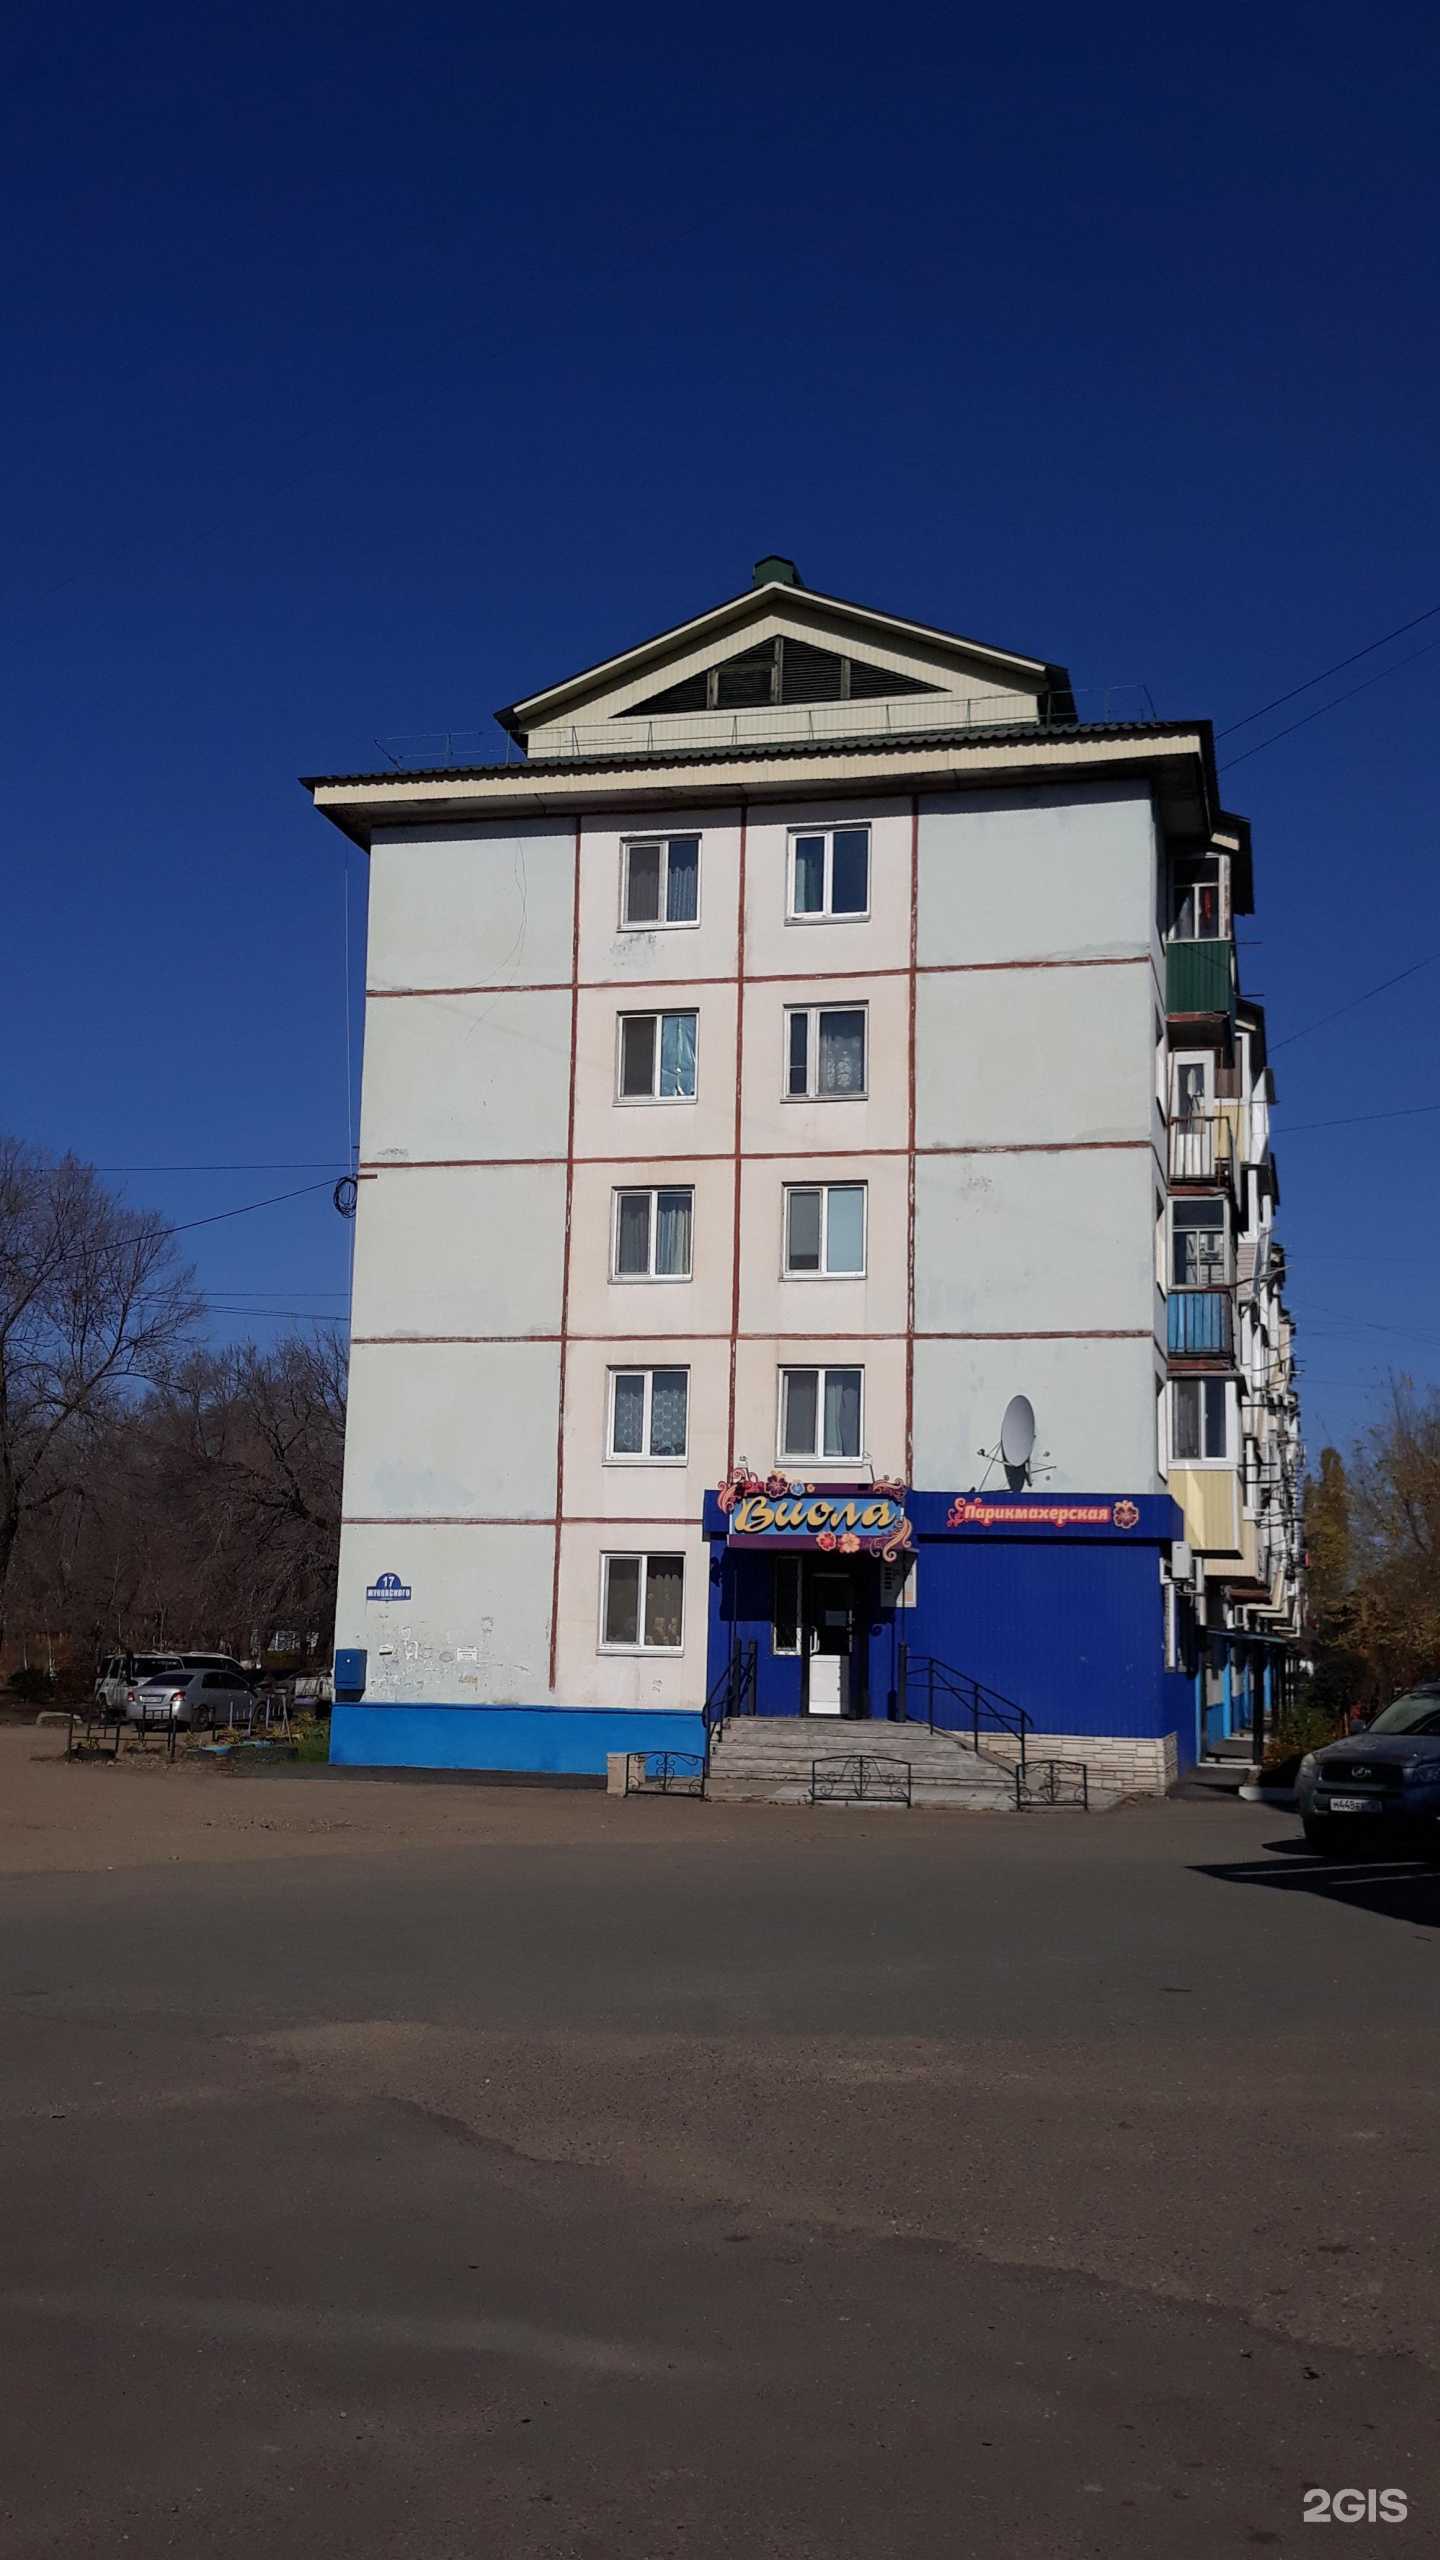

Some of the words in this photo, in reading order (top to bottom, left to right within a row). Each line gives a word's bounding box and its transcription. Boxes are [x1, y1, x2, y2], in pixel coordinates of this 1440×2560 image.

[734, 1496, 896, 1533] Виола
[964, 1504, 1109, 1525] Парикмахерская
[383, 1576, 395, 1588] 17
